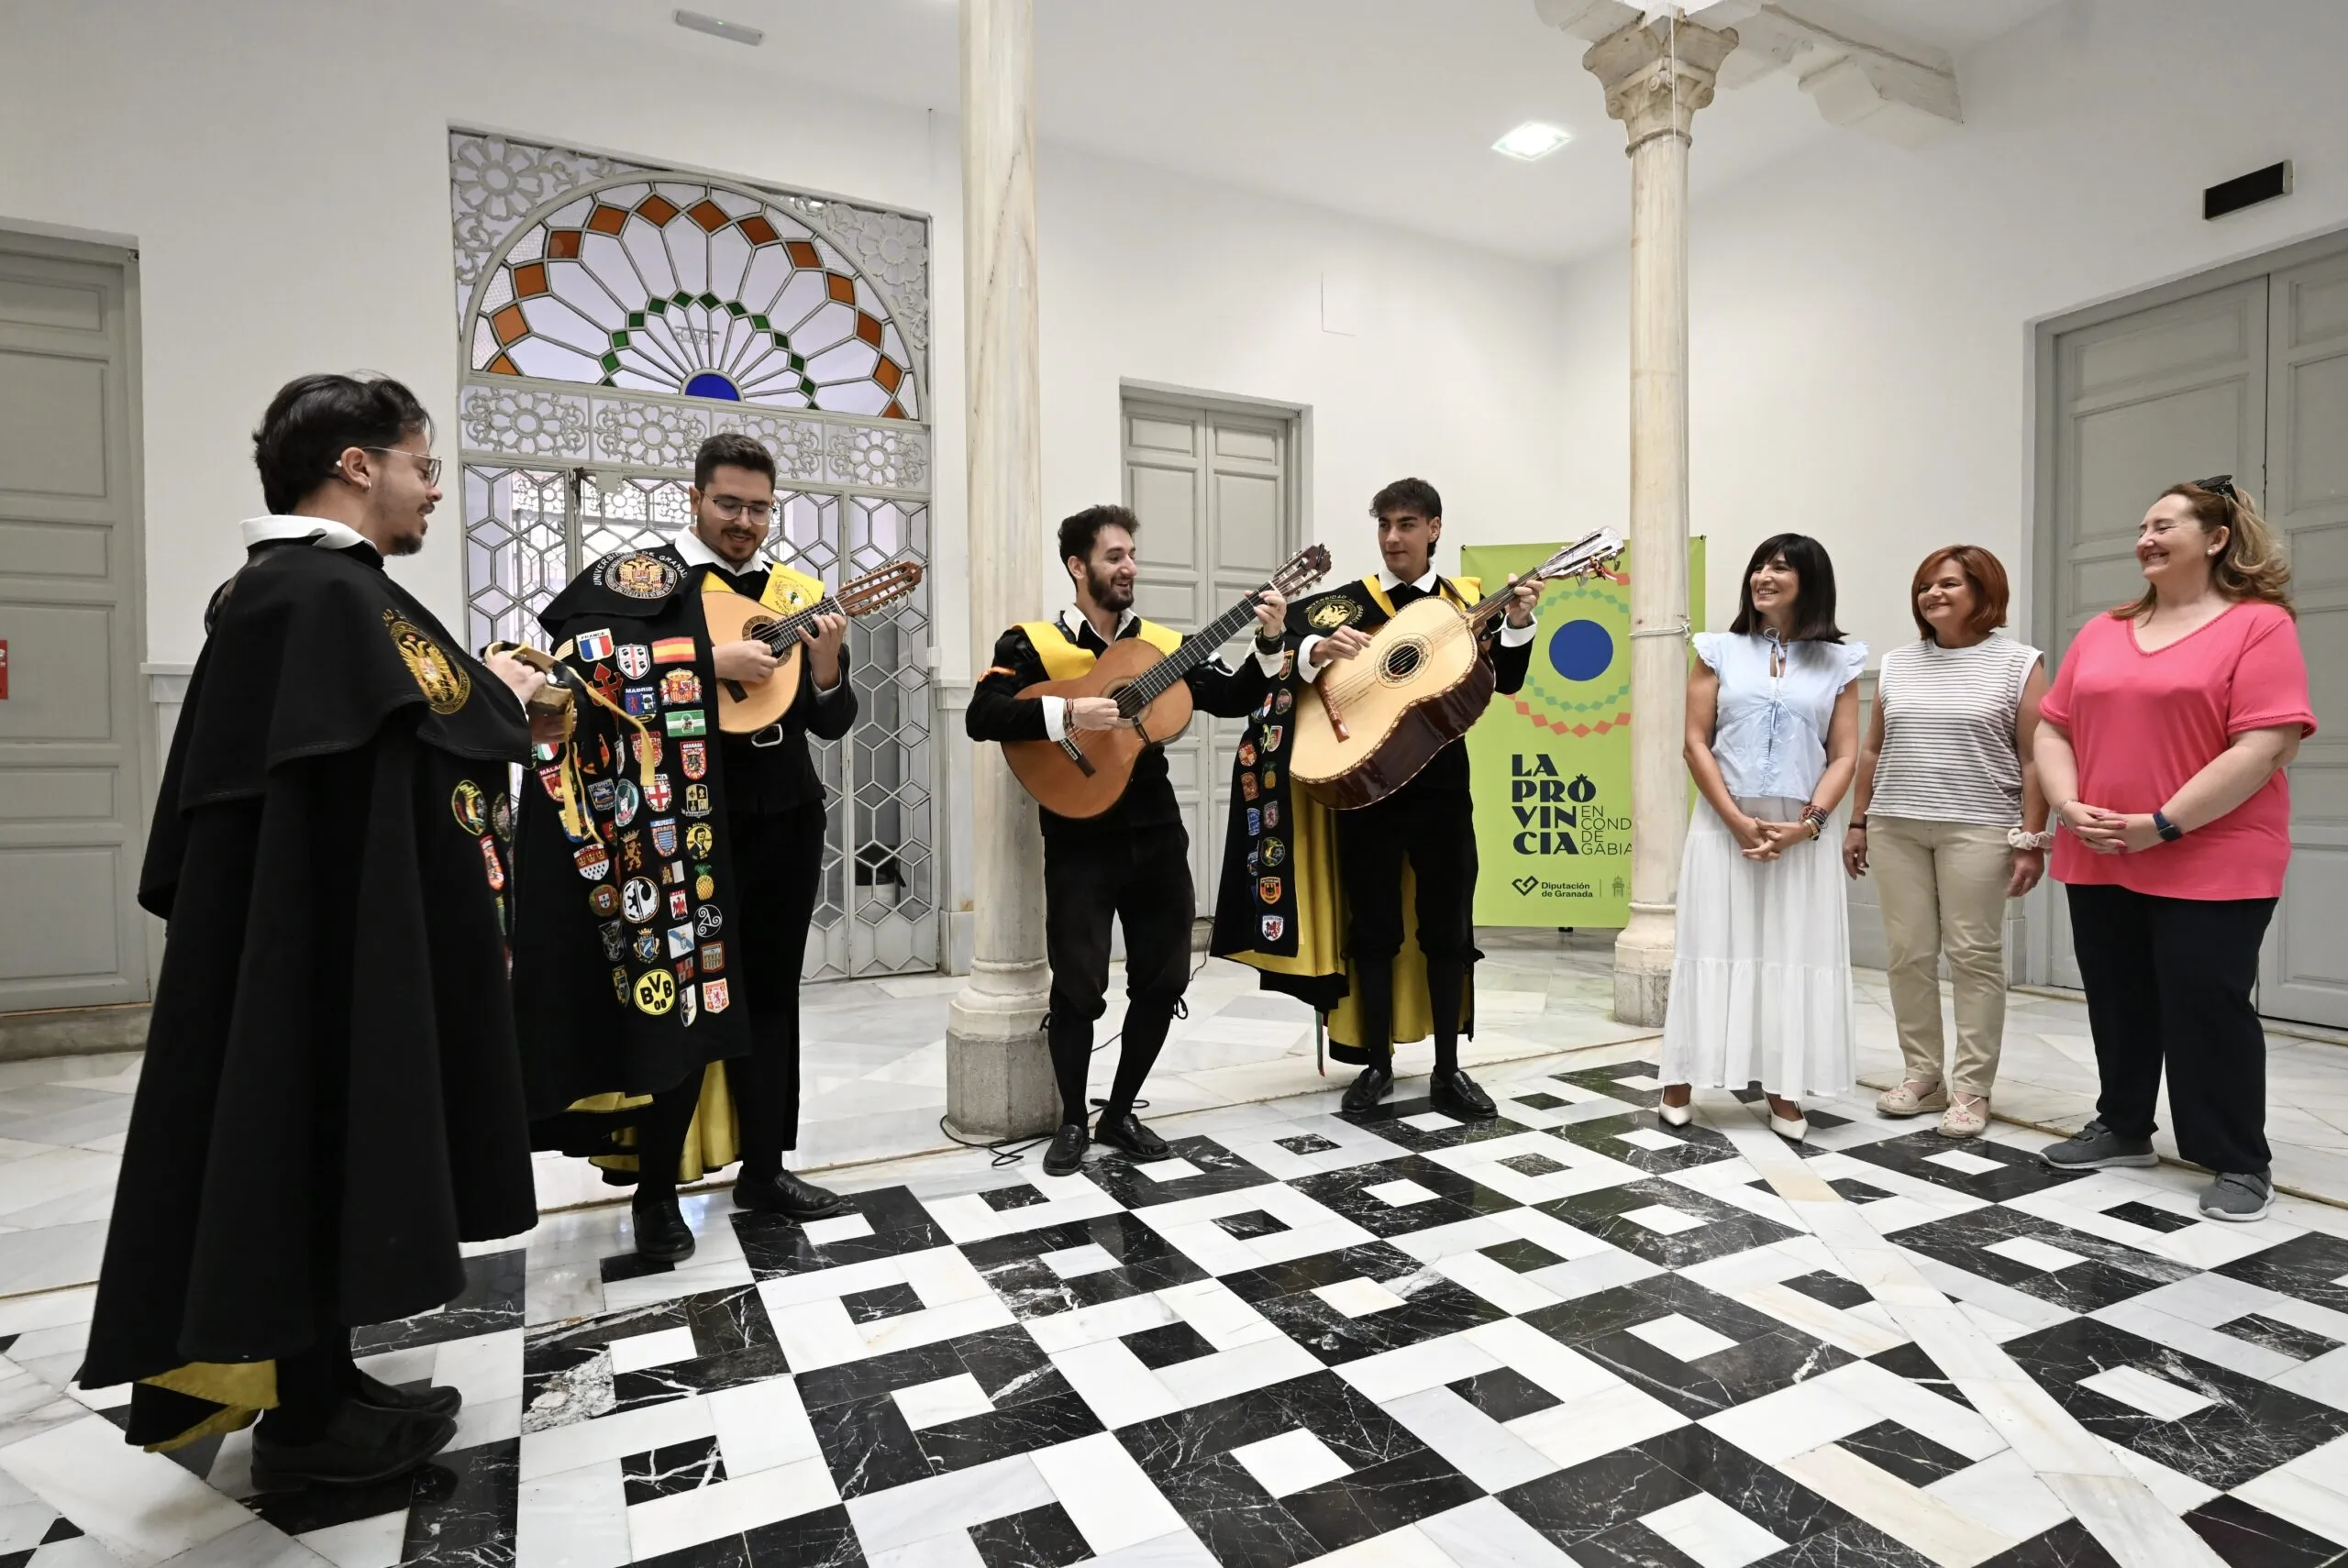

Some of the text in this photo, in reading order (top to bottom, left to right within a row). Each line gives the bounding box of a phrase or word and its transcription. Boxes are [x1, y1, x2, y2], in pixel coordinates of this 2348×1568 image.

[659, 555, 688, 580] GRANAD
[581, 631, 605, 640] FRANCE
[625, 686, 654, 694] MADRID
[1512, 754, 1558, 777] LA
[1512, 806, 1577, 829] VIN
[1581, 805, 1603, 818] EN
[1512, 832, 1579, 855] CIA
[1581, 831, 1604, 843] DE
[1541, 881, 1590, 890] Diputación
[639, 973, 672, 1006] BVB
